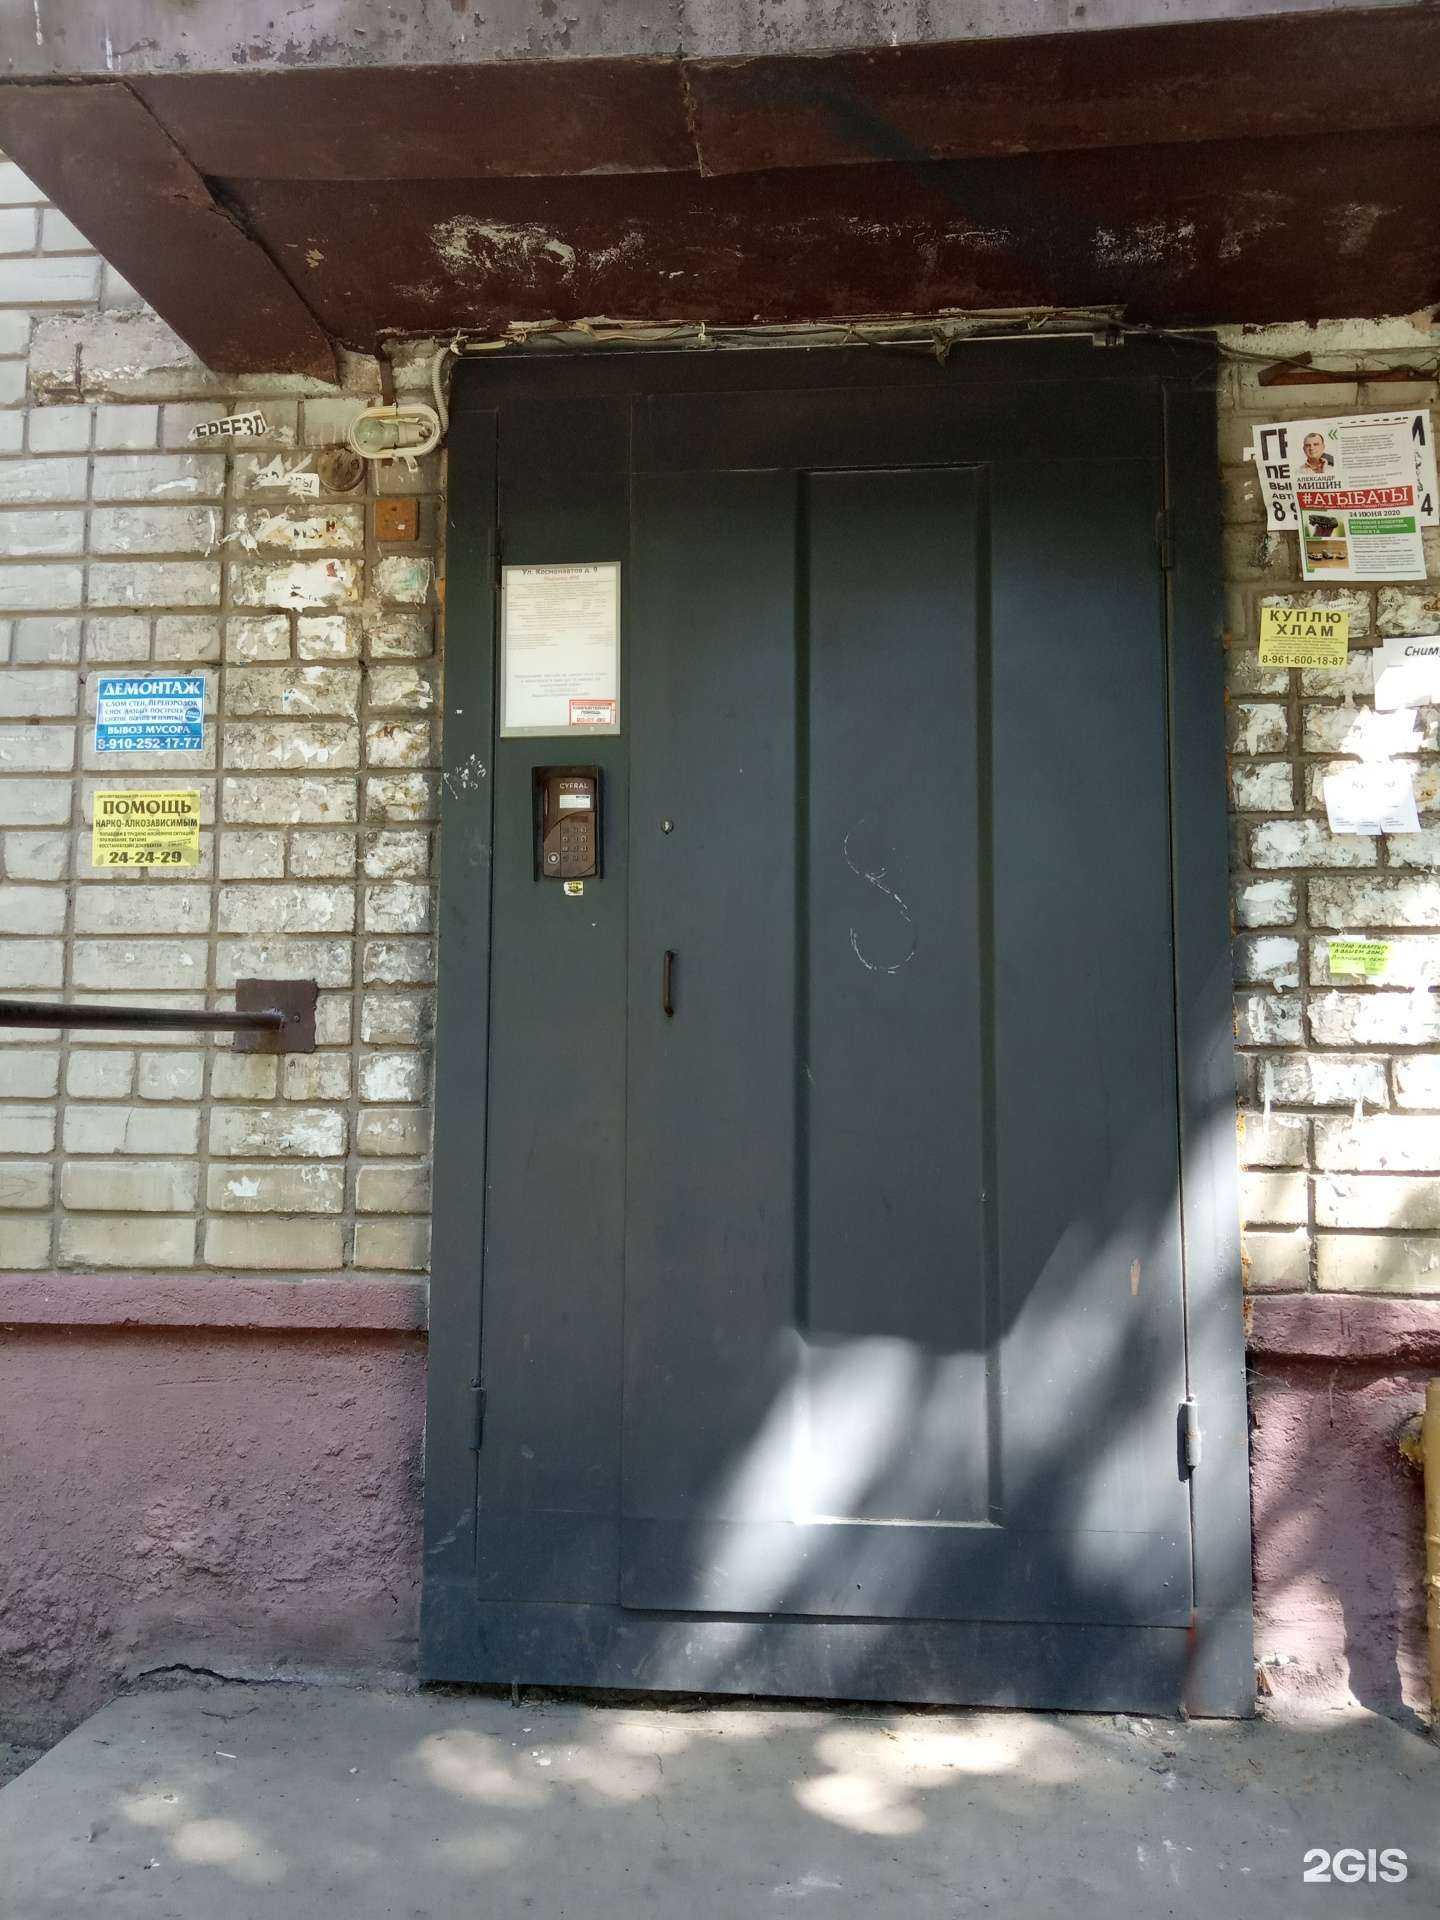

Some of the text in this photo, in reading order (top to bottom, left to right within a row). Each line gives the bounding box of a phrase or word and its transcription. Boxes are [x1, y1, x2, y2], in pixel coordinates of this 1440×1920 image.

[1298, 481, 1341, 490] МИШИН
[1302, 487, 1409, 505] #АТЫБАТЫ
[1270, 610, 1341, 623] КУПЛЮ
[1276, 623, 1334, 637] ХЛАМ
[1404, 646, 1440, 658] Сним
[1262, 655, 1345, 665] 8-961-600-18-87
[103, 681, 200, 696] ДЕМОНТАЖ
[107, 725, 191, 734] ВЫВОЗ МУСОРА
[97, 737, 201, 750] 8-910-252-17-77
[559, 782, 589, 790] CYFRAL
[103, 800, 192, 816] ПОМОЩЬ
[95, 819, 198, 828] НАРКО-АЛКОЗАВИСИМЫМ
[108, 851, 182, 863] 24-24-29
